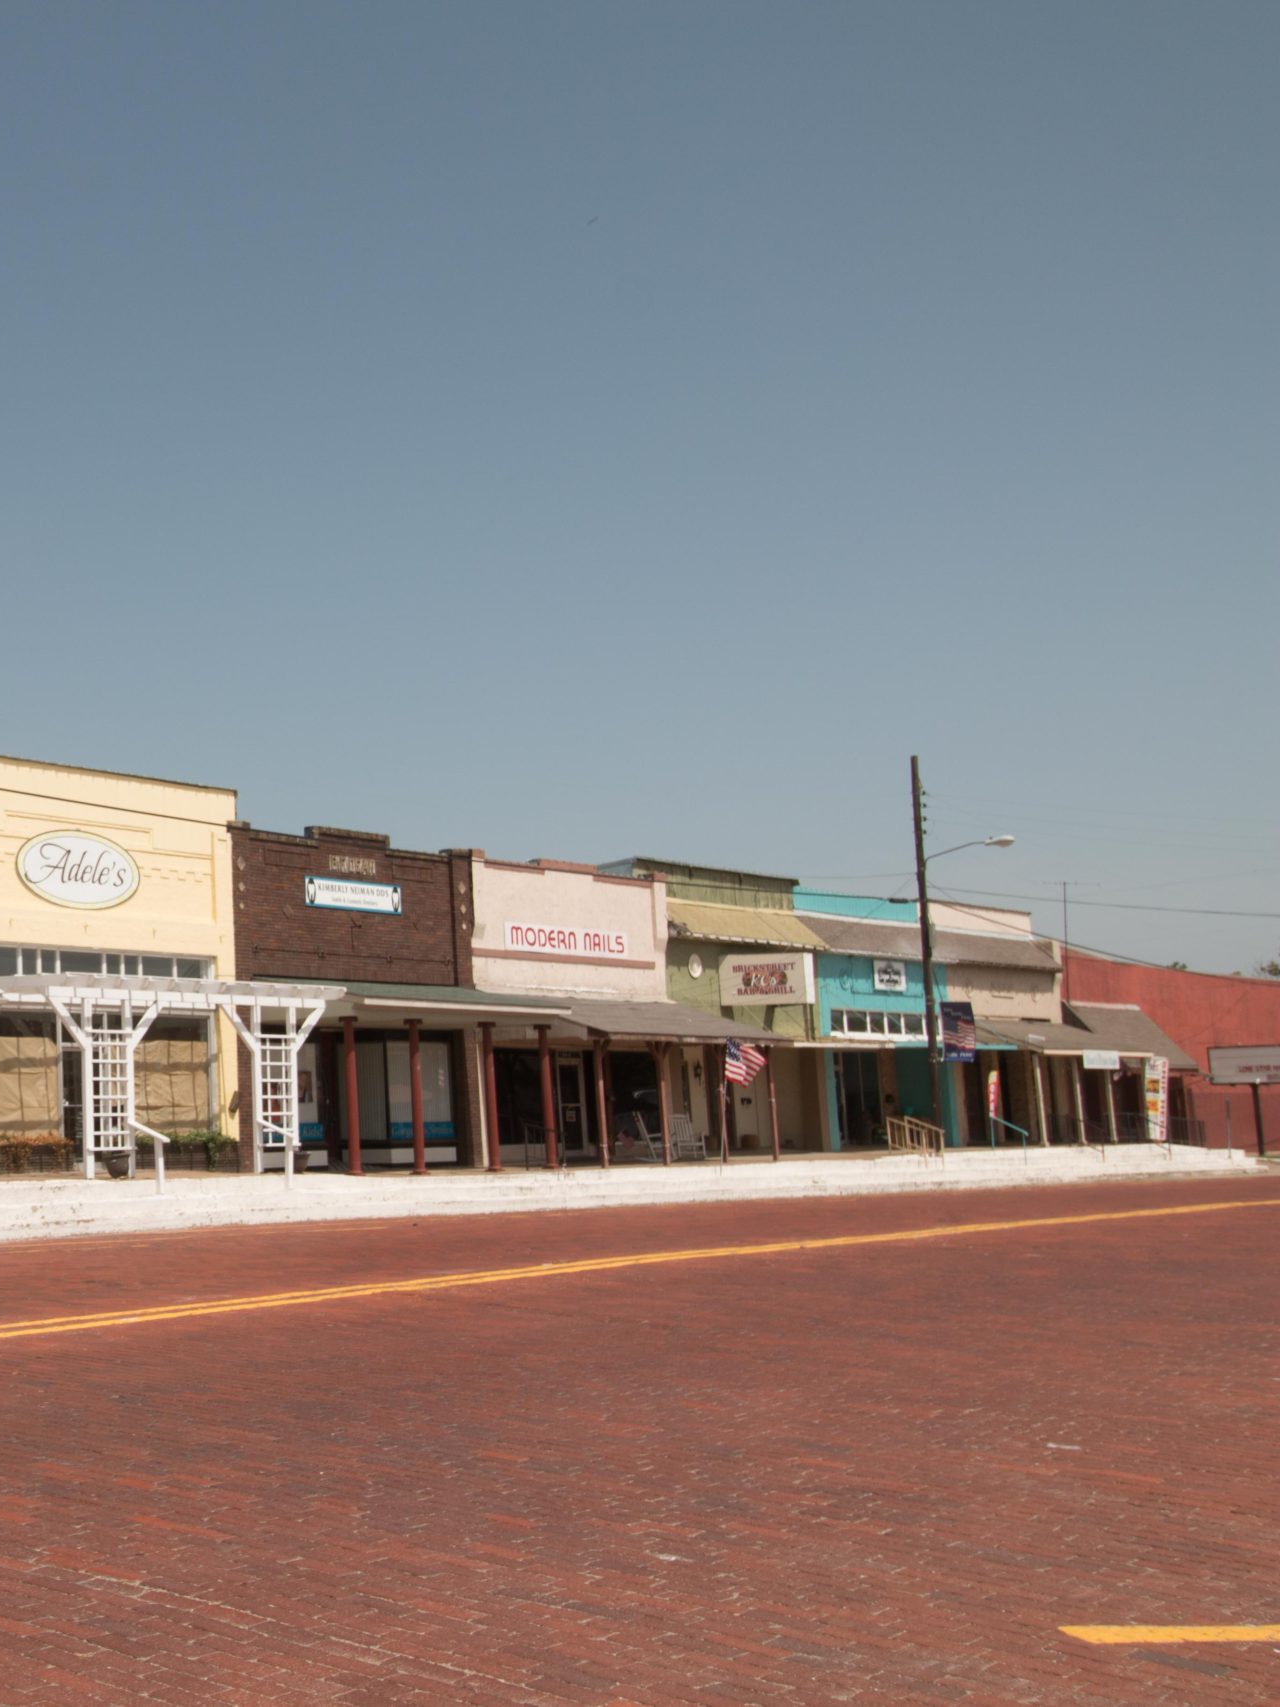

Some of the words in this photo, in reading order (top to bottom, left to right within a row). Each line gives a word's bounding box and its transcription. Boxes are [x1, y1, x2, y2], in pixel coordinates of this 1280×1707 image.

[24, 842, 127, 888] Adele's
[318, 882, 348, 894] KIMBERLY
[376, 889, 389, 898] DDS
[510, 925, 577, 951] MODERN
[583, 931, 625, 954] NAILS
